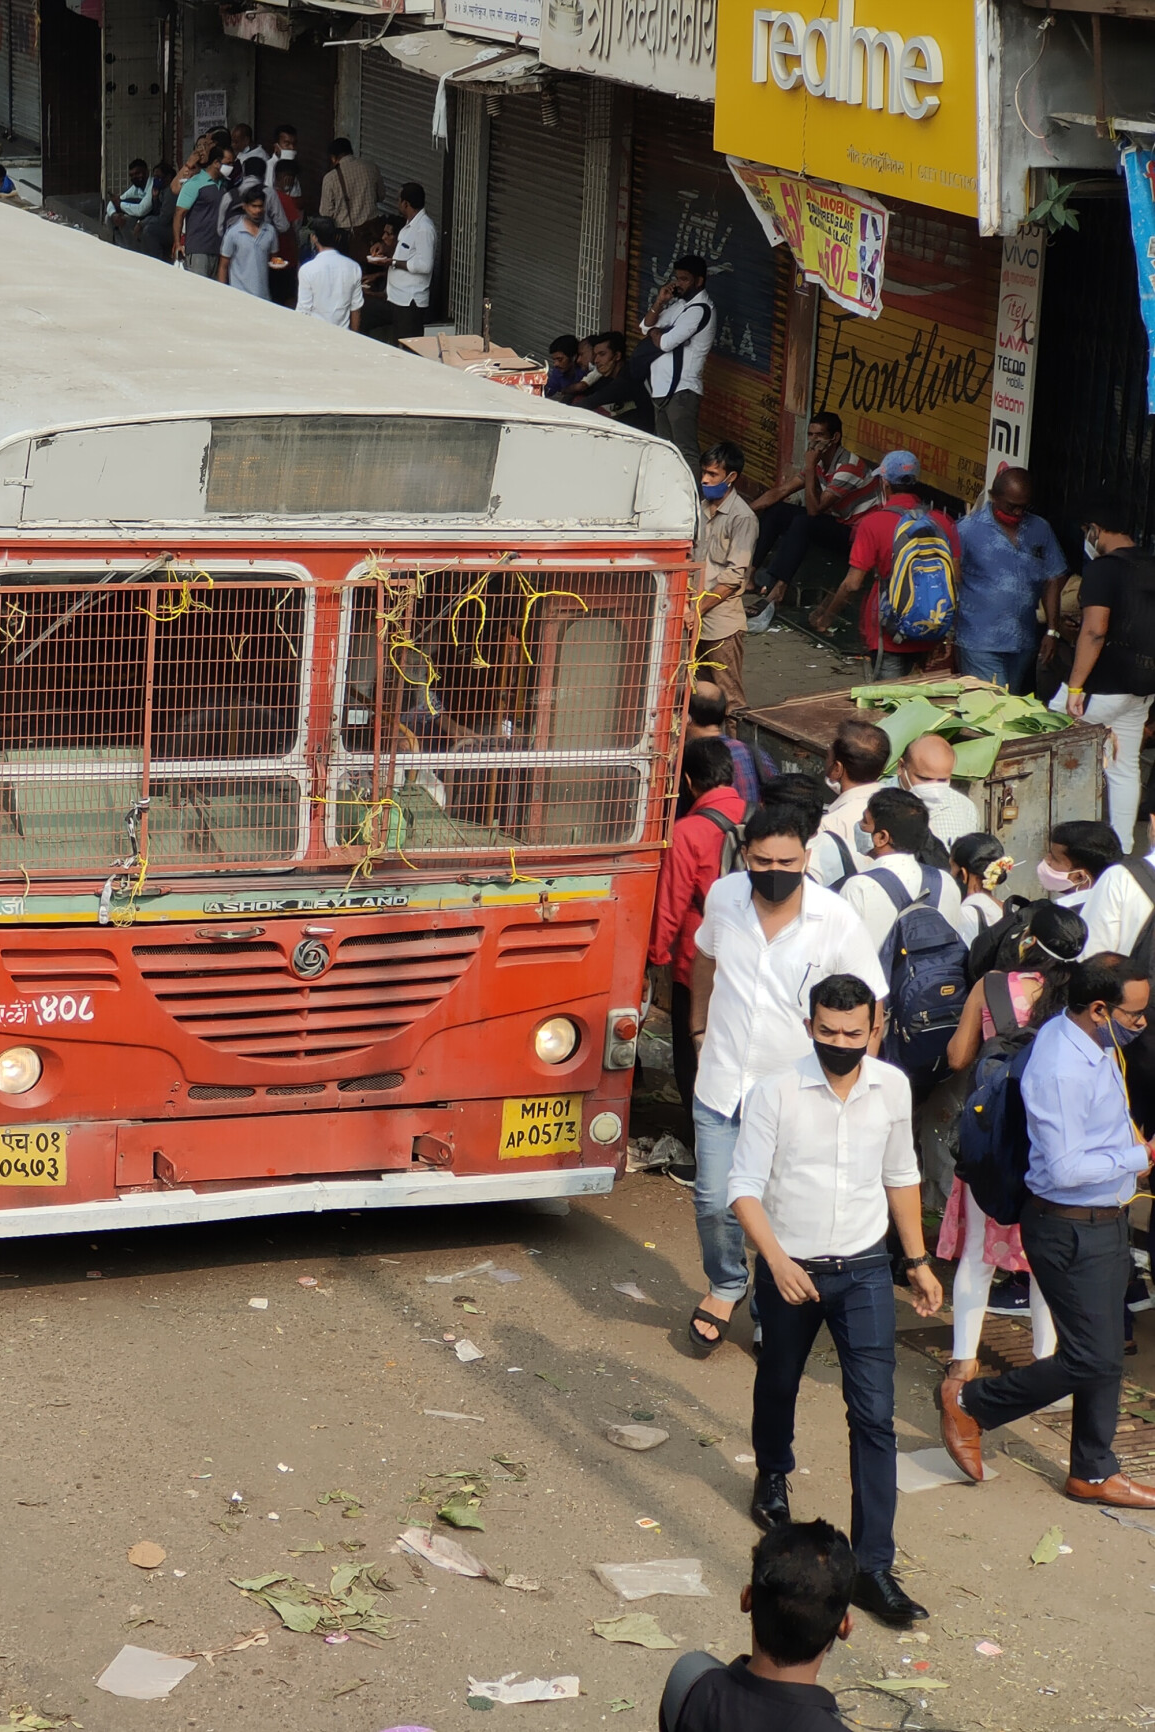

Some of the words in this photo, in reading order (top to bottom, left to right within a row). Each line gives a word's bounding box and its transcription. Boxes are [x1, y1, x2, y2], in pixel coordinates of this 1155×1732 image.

[752, 0, 944, 120] realme
[820, 195, 855, 221] MOBILE
[999, 332, 1029, 355] LAVA
[818, 311, 995, 415] Frontline
[205, 901, 288, 913] ASHOK
[298, 896, 408, 911] LEYLAND
